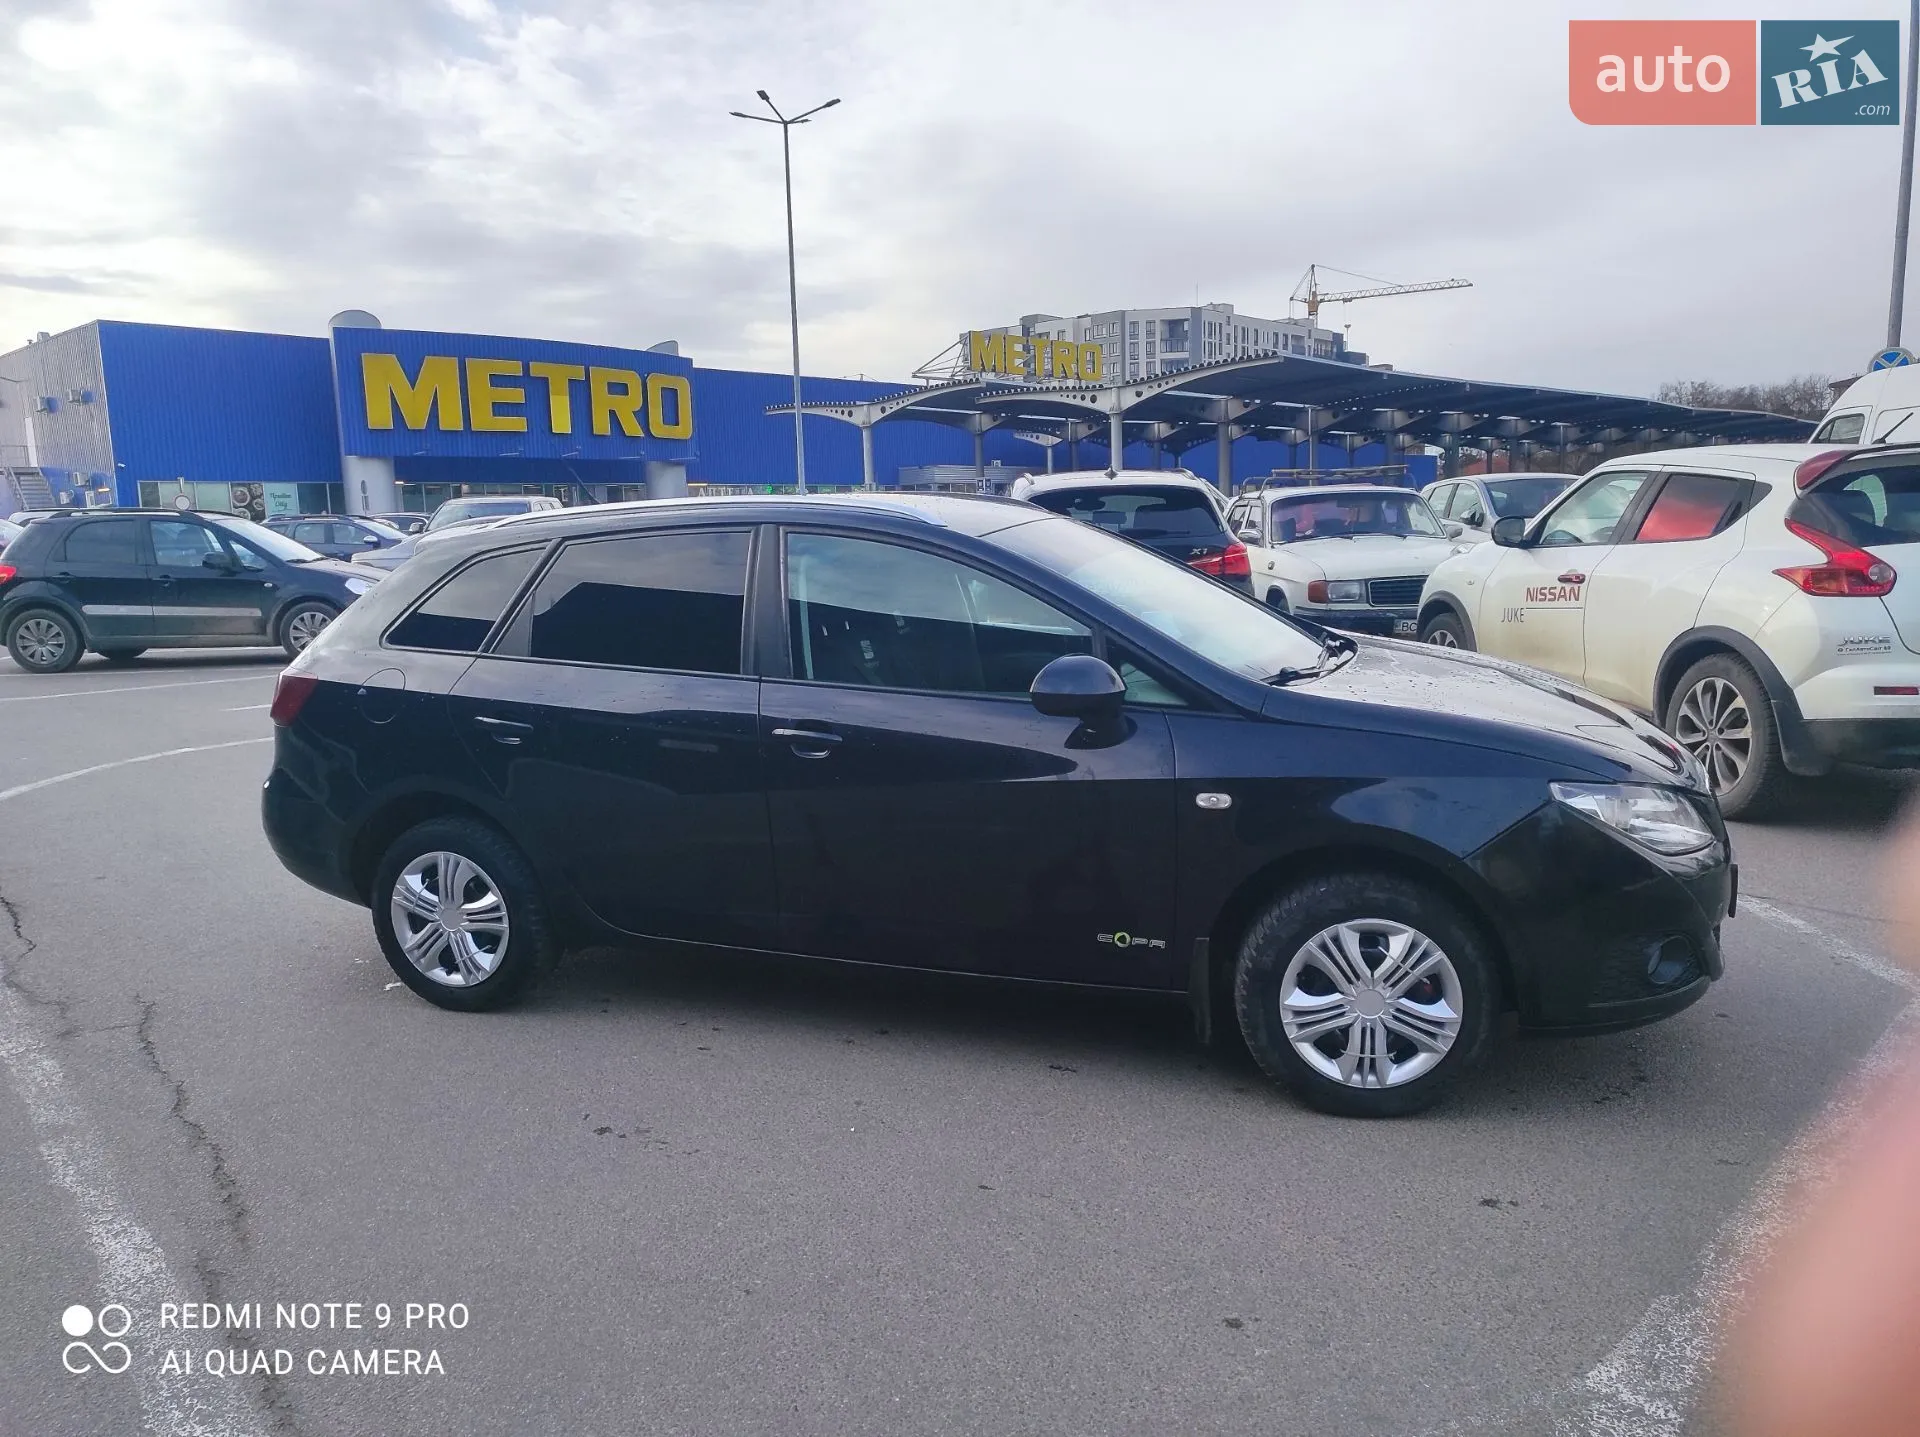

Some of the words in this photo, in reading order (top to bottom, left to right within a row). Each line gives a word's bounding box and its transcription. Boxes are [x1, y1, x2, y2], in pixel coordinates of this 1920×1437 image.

[970, 331, 1103, 381] METRO
[361, 353, 693, 440] METRO
[1525, 585, 1581, 602] NISSAN
[1501, 607, 1525, 623] JUKE
[1837, 635, 1891, 647] JUKE
